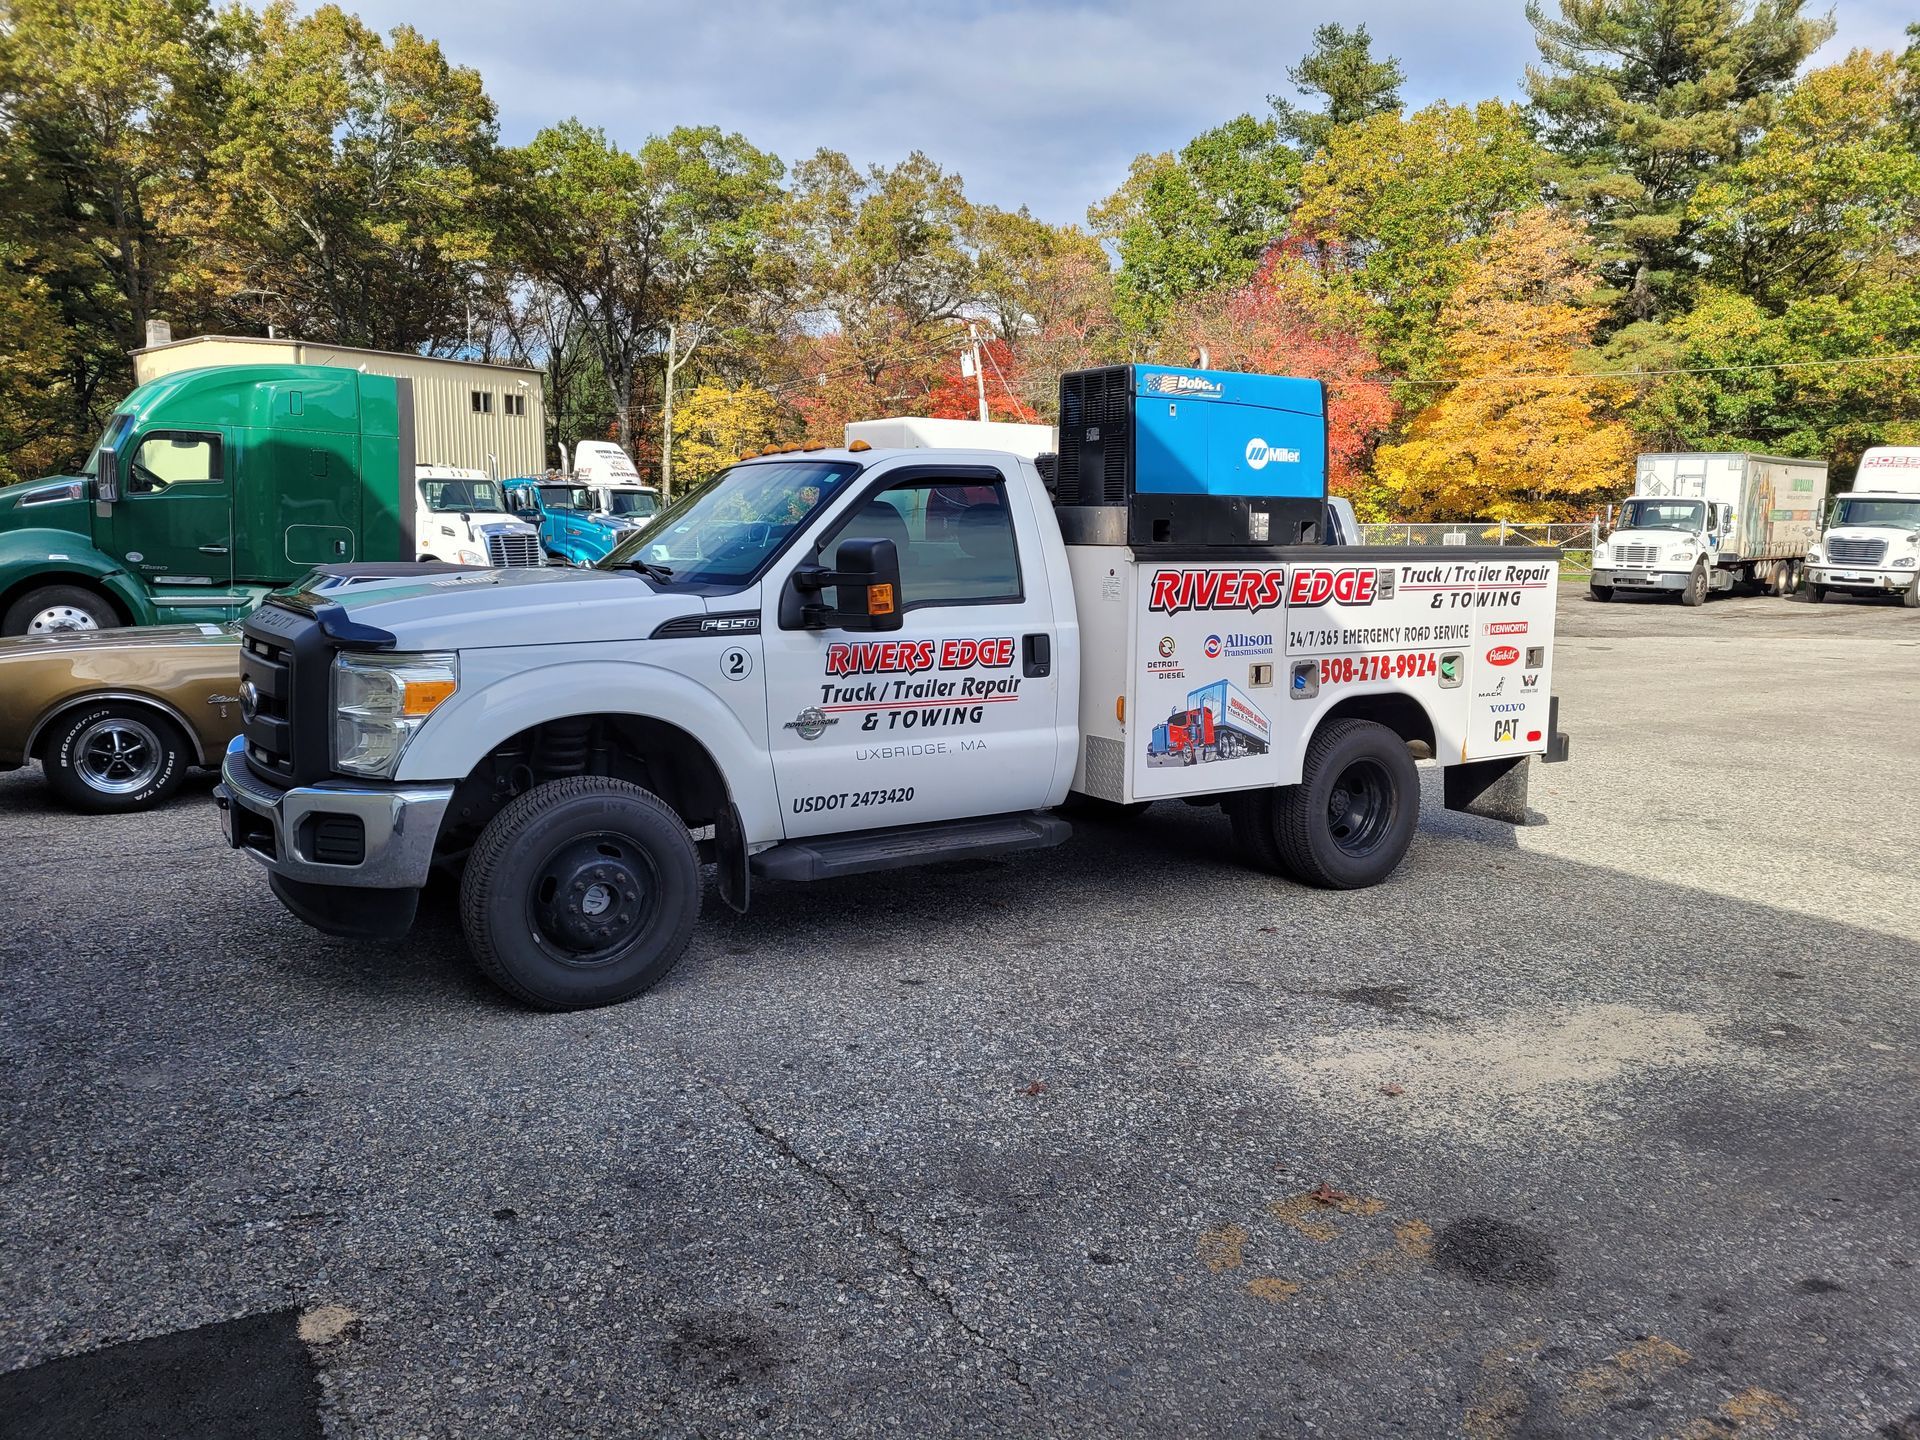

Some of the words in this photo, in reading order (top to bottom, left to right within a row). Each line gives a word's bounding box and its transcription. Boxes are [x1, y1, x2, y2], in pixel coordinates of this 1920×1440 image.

[1269, 447, 1300, 463] Miller
[1401, 566, 1441, 583] Truck
[1454, 566, 1501, 583] Trailer
[1505, 565, 1550, 586] Repair
[1148, 568, 1285, 617] RIVERS
[1285, 567, 1378, 608] EDGE
[1430, 593, 1443, 608] &
[1450, 591, 1521, 608] TOWING
[265, 612, 298, 630] DUTY
[1491, 622, 1528, 634] KENWORTH
[1224, 633, 1273, 648] Allison
[1289, 629, 1339, 648] 24/7/365
[1343, 626, 1401, 645] EMERGENCY
[1404, 625, 1431, 641] ROAD
[1433, 624, 1469, 640] SERVICE
[729, 652, 744, 674] 2
[825, 640, 935, 679] RIVERS
[938, 637, 1015, 671] EDGE
[1223, 647, 1273, 657] Transmission
[1489, 649, 1518, 662] Peterbilt
[1147, 660, 1179, 669] DETROIT
[1320, 652, 1437, 684] 508-278-9924
[821, 682, 882, 703] Truck
[893, 678, 956, 700] Trailer
[961, 675, 1021, 700] Repair
[861, 712, 878, 731] &
[888, 706, 984, 730] TOWING
[1490, 703, 1526, 713] VOLVO
[60, 710, 110, 767] BFGoodrich
[1494, 718, 1519, 742] CAT
[856, 742, 952, 761] UXBRIDGE,
[961, 739, 987, 751] MA
[156, 751, 175, 788] Radial
[793, 793, 848, 814] USDOT
[850, 786, 915, 808] 2473420
